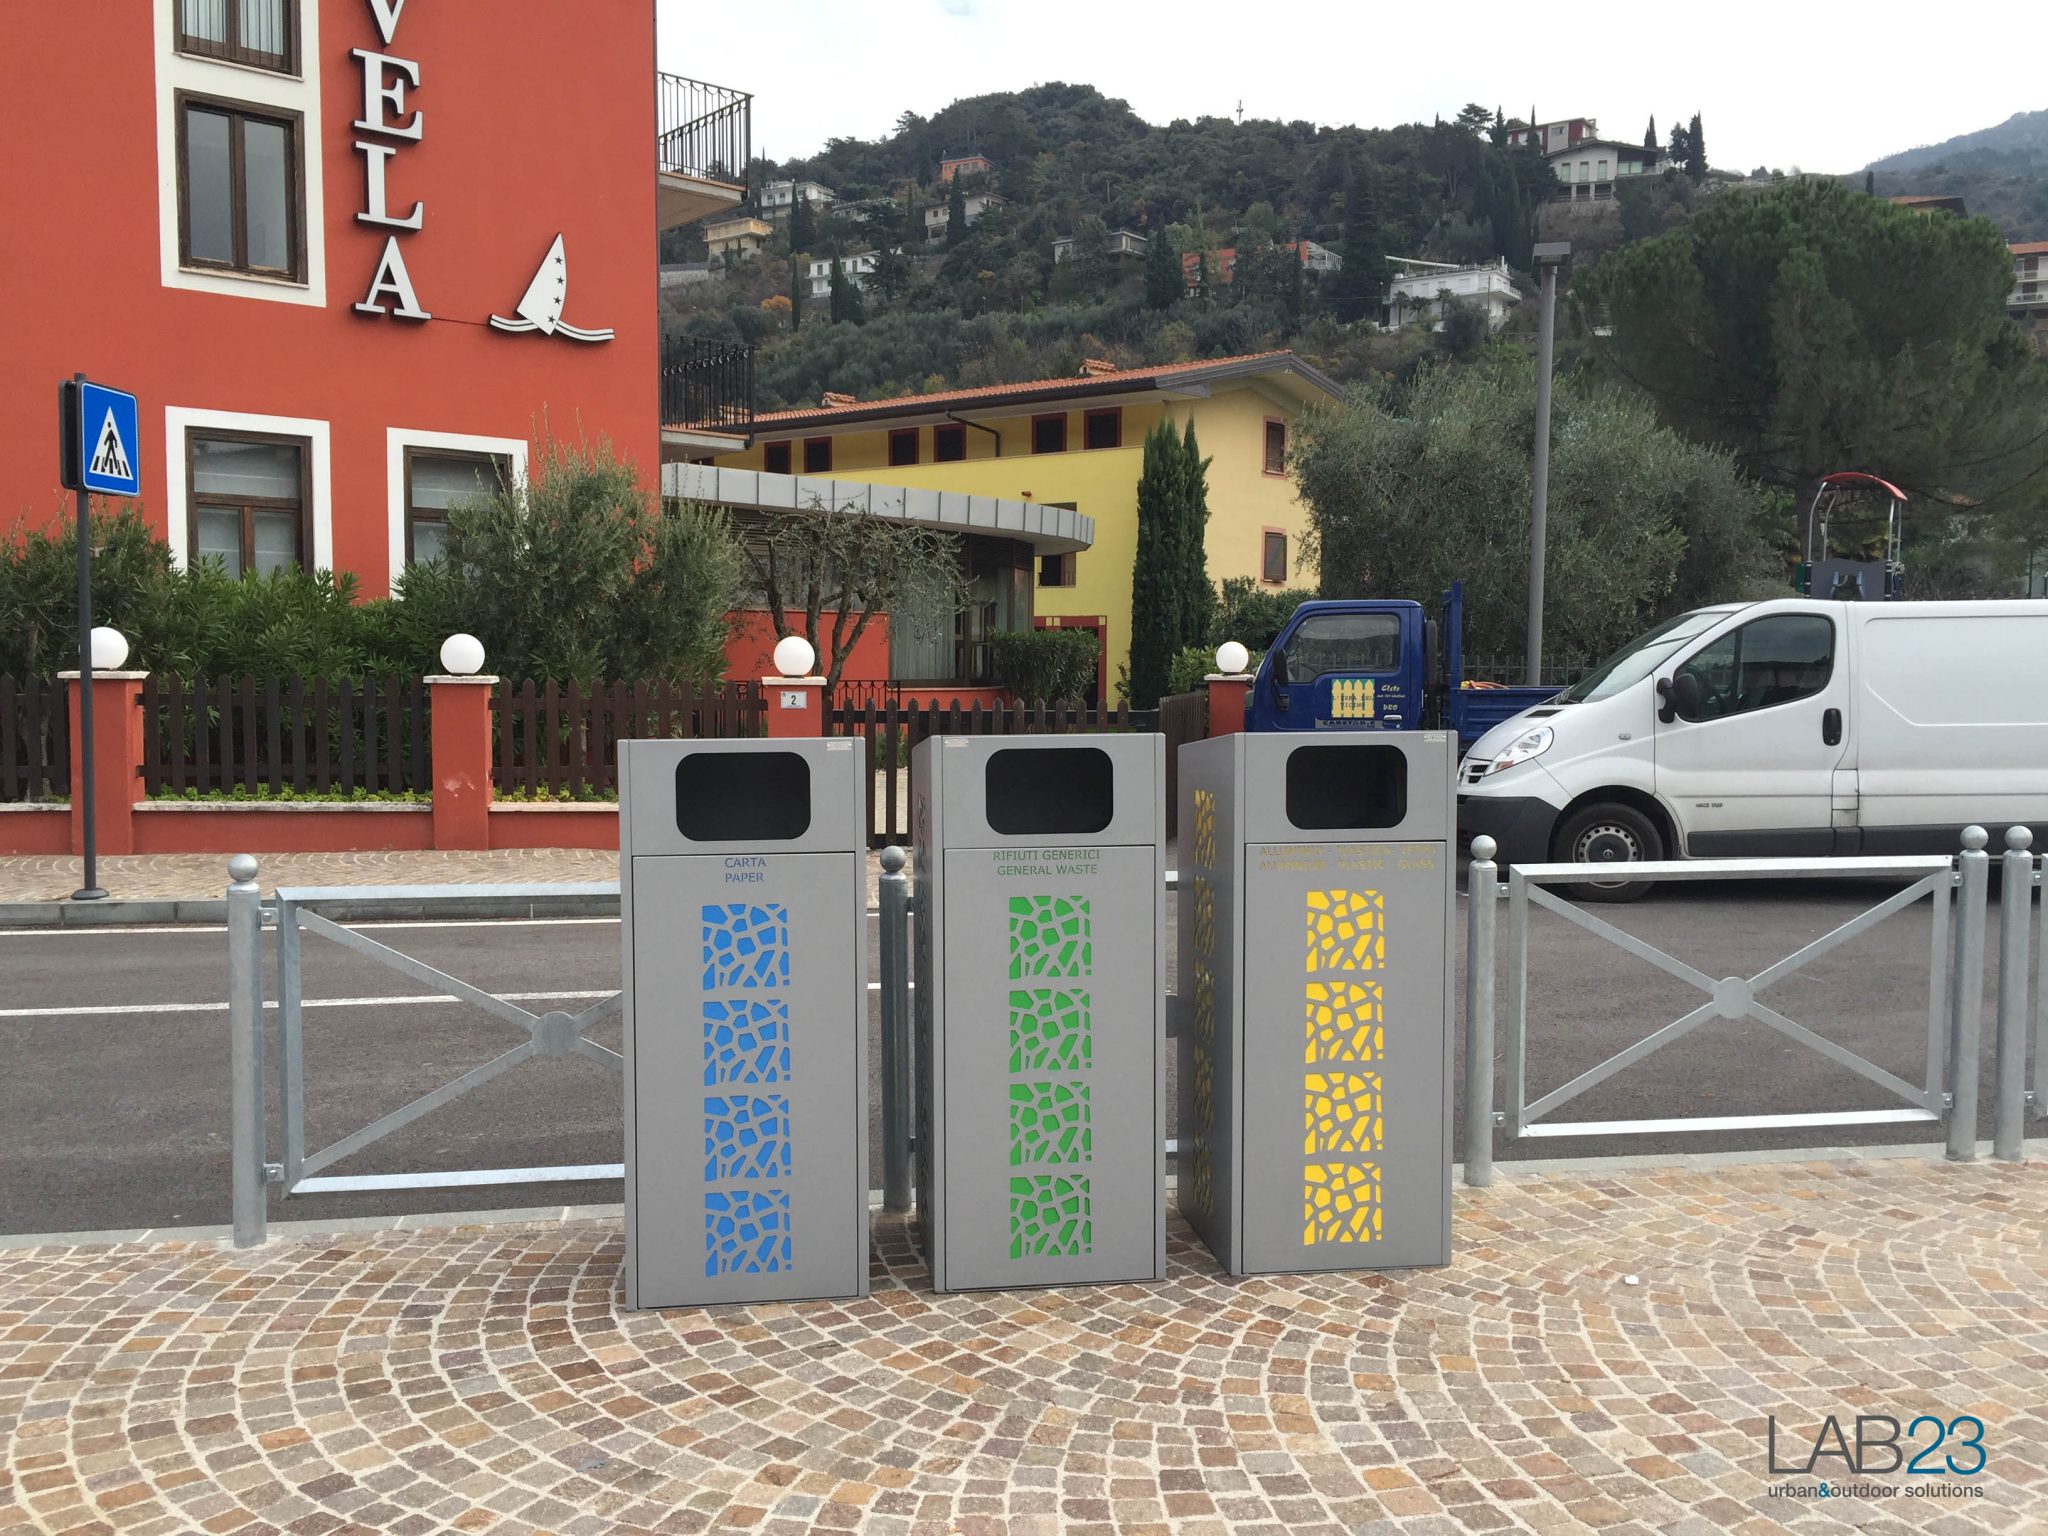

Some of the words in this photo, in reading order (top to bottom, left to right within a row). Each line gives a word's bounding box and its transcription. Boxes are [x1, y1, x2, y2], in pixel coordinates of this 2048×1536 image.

[790, 694, 797, 706] 2
[993, 850, 1038, 861] RIFIUTI
[1042, 849, 1100, 860] GENERICI
[724, 857, 766, 868] CARTA
[997, 865, 1053, 876] GENERAL
[1056, 864, 1098, 875] WASTE
[725, 872, 765, 883] PAPER
